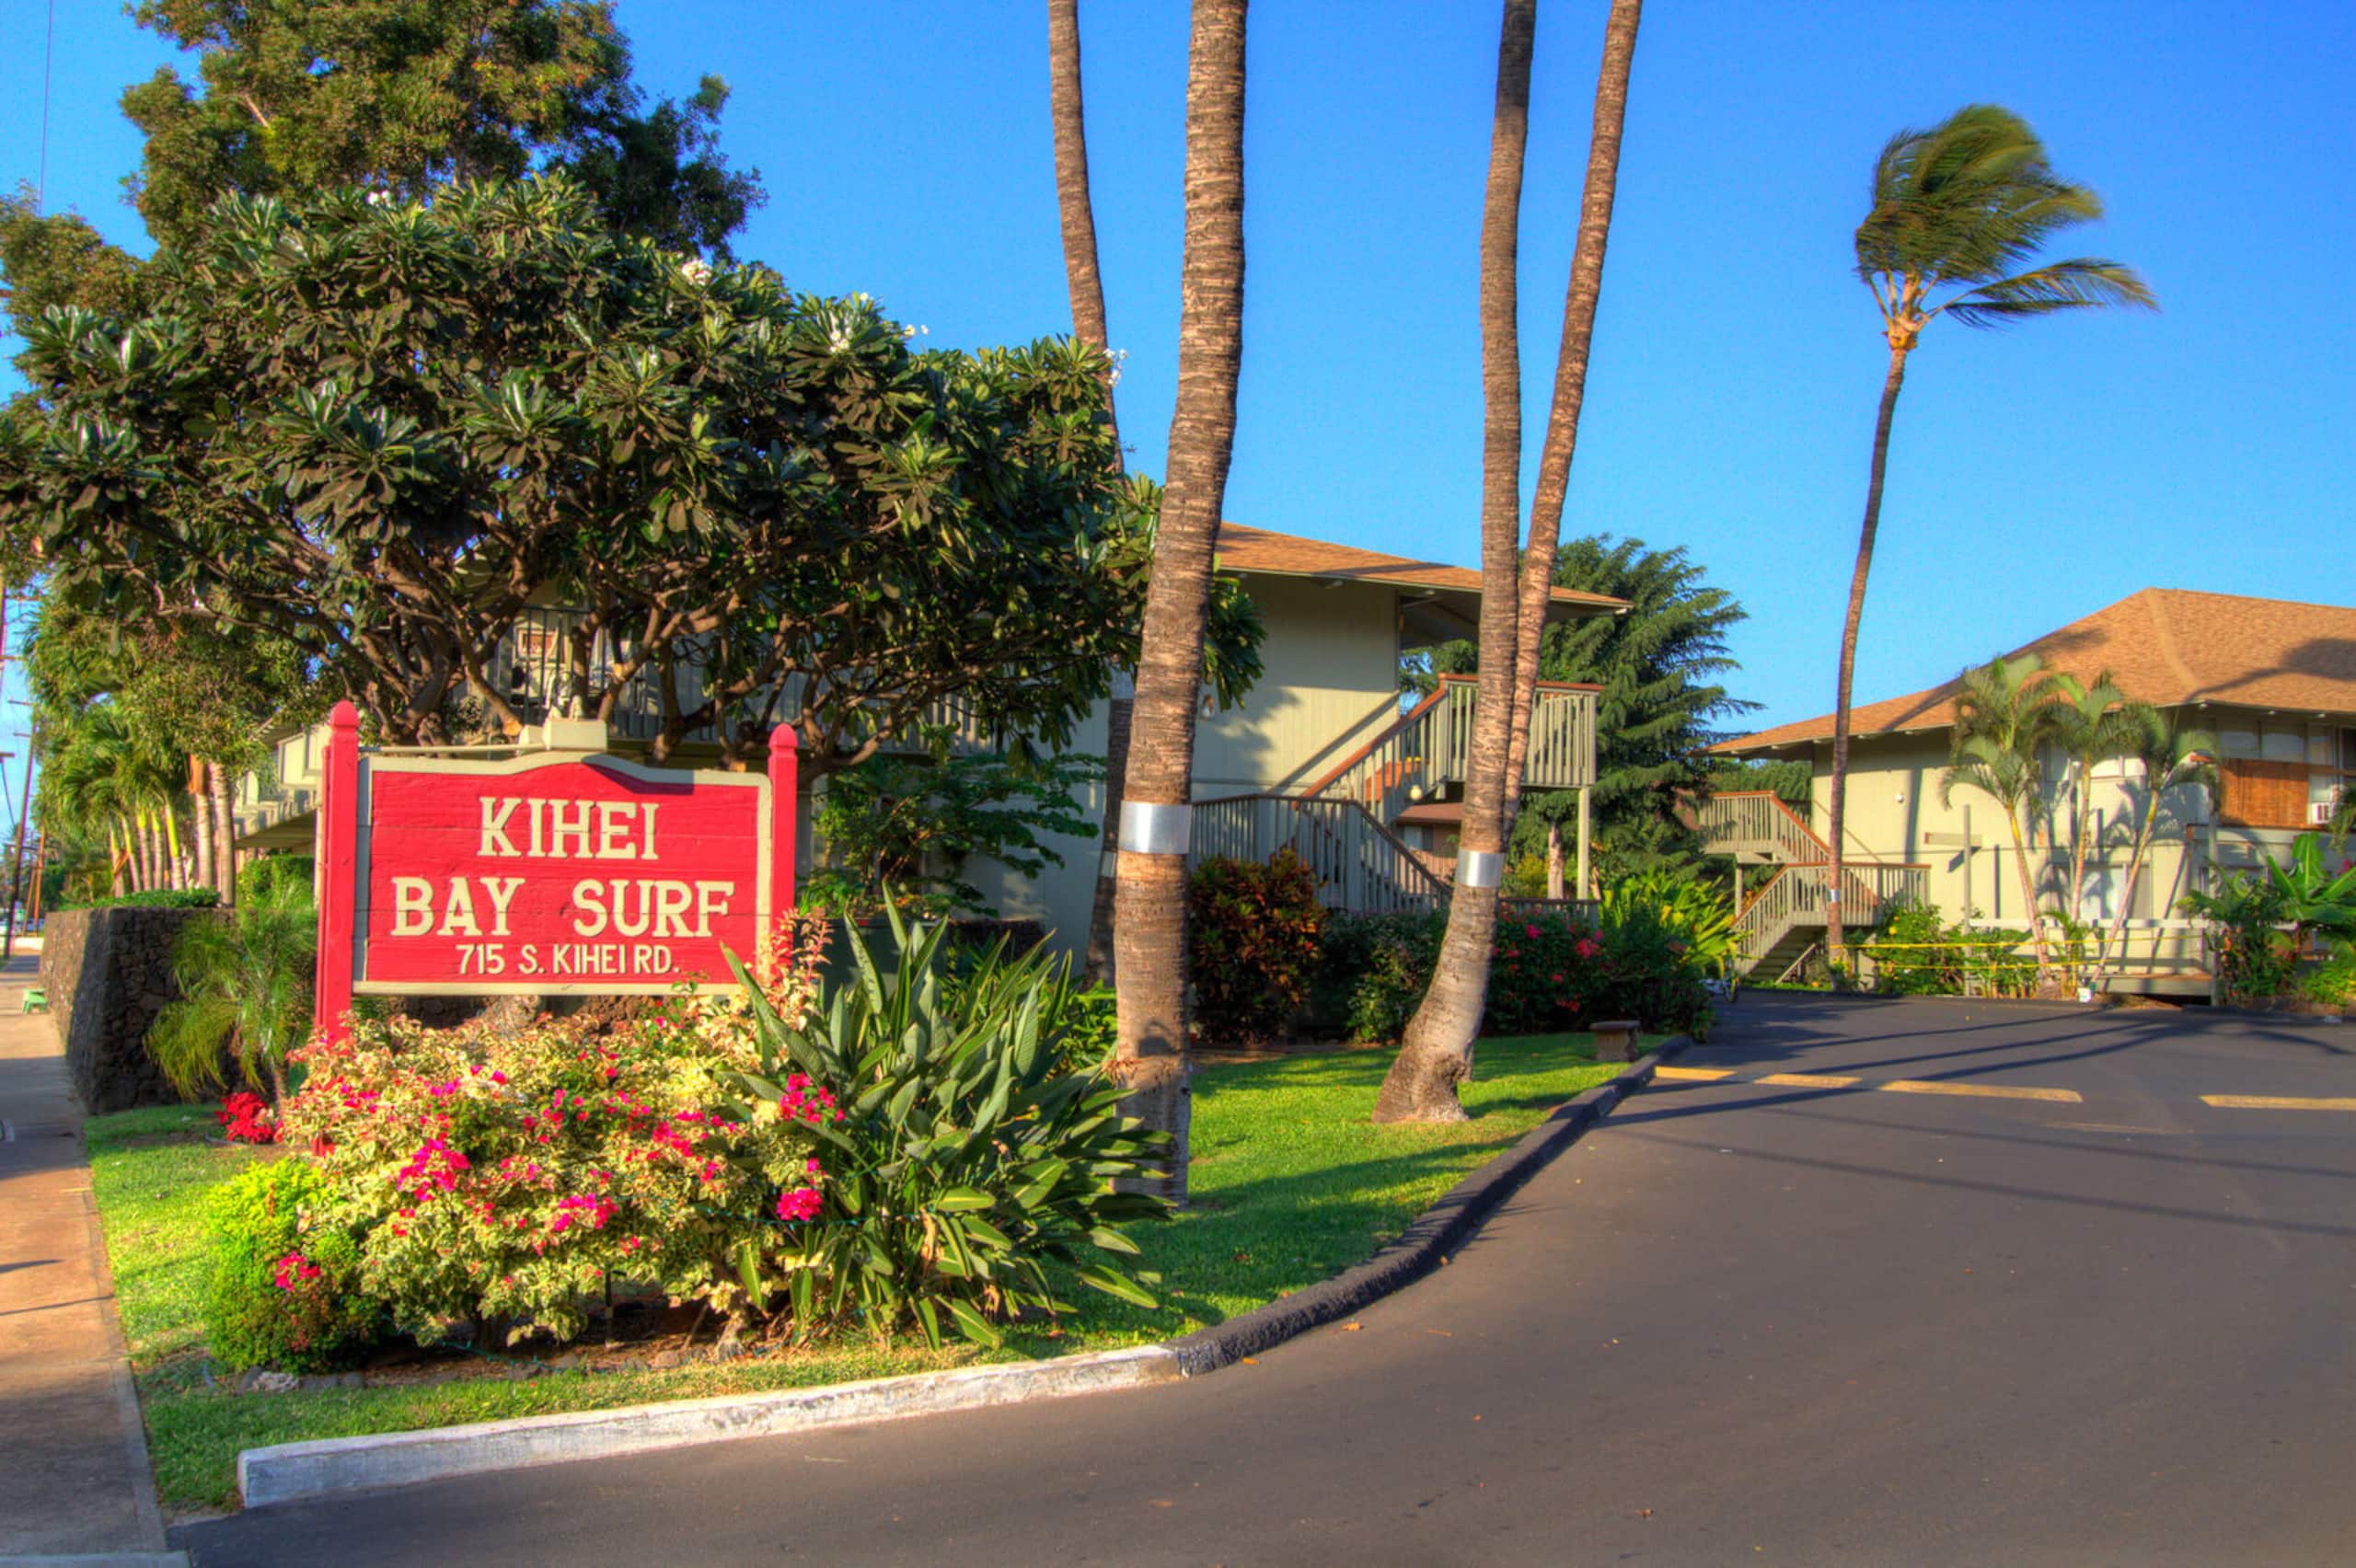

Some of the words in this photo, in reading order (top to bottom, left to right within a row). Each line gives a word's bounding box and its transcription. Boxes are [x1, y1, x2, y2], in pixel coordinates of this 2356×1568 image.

[477, 797, 659, 860] KIHEI
[390, 876, 525, 936] BAY
[572, 879, 734, 938] SURF
[456, 943, 505, 974] 715
[518, 943, 545, 974] S.
[553, 943, 626, 974] KIHEI
[633, 943, 680, 974] RD.
